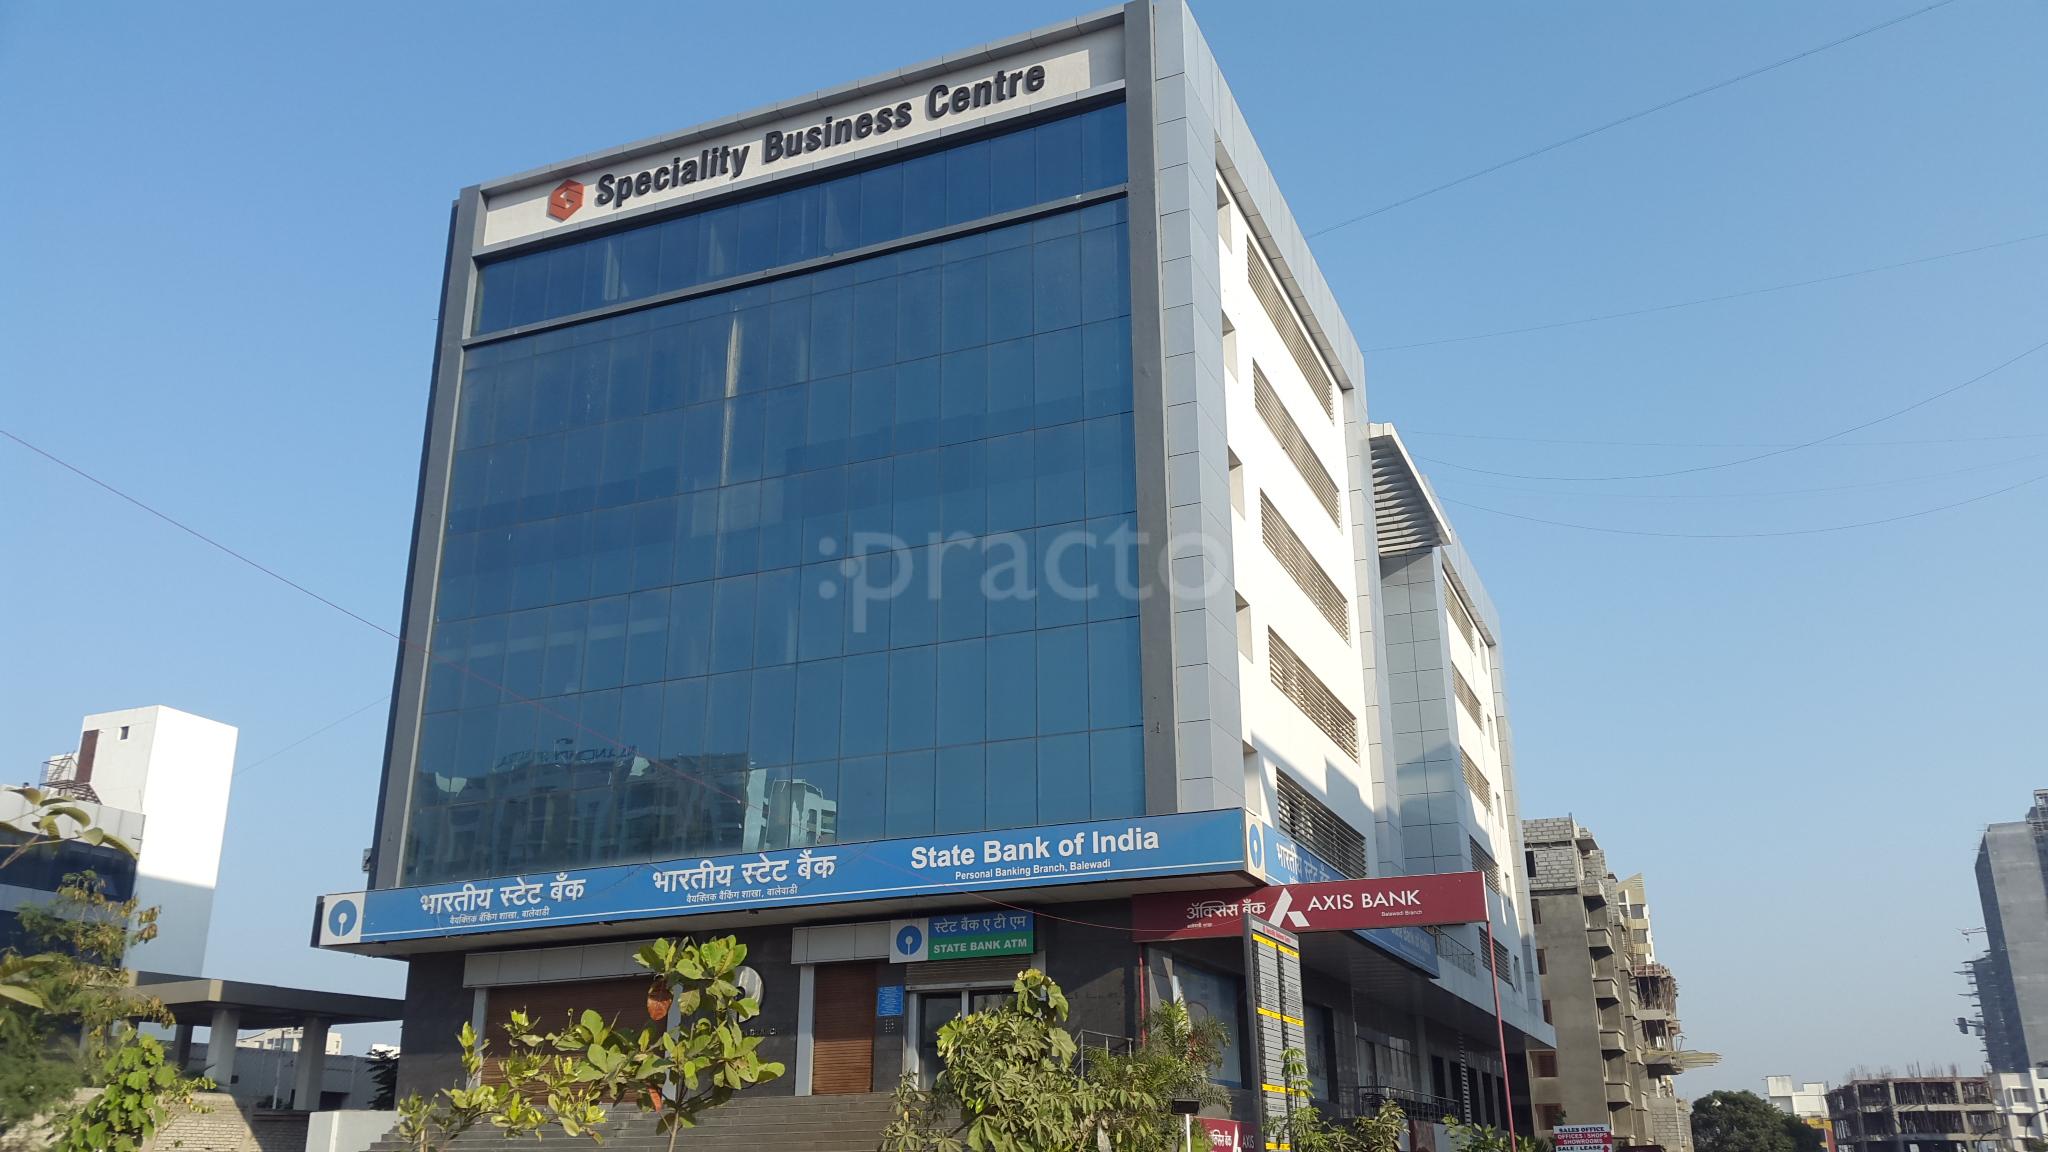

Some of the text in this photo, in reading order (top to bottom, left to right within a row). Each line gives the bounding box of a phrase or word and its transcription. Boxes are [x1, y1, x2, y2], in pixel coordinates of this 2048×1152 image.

[596, 64, 1046, 208] Speciality Business Centre
[910, 827, 1159, 869] State Bank of India
[652, 848, 838, 893] भारतीय स्टेट बैंक
[955, 859, 1111, 880] Personal Banking Branch, Balewadi
[420, 883, 494, 915] भारतीय
[500, 877, 544, 907] स्टेट
[1307, 889, 1422, 912] AXIS BANK
[934, 917, 959, 933] स्टेट
[993, 913, 1007, 929] टी
[1009, 916, 1027, 930] एम
[933, 938, 1027, 954] STATE BANK ATM
